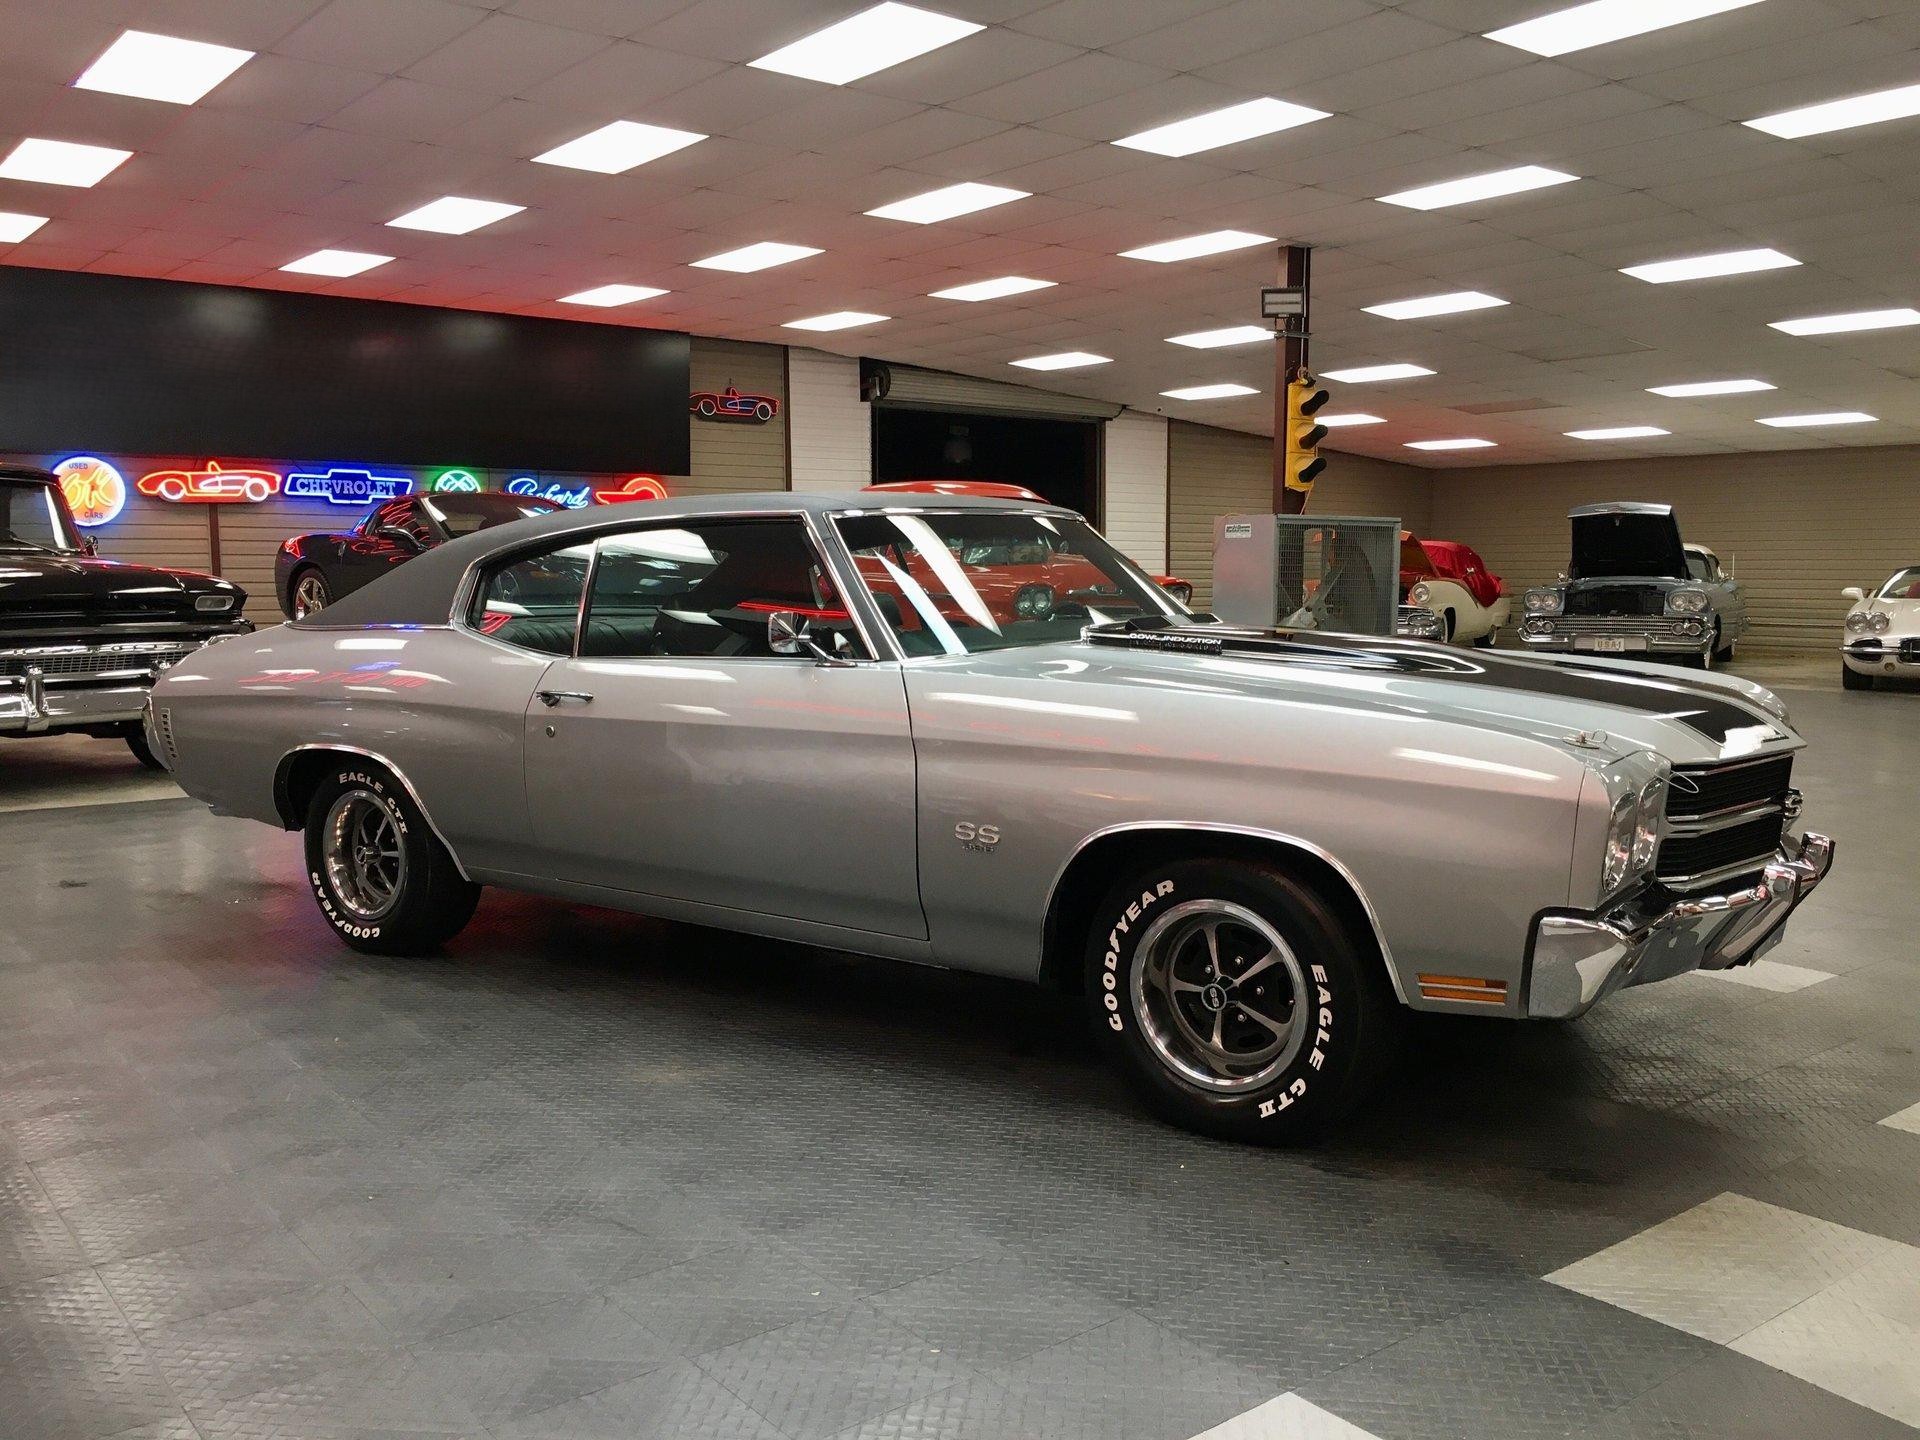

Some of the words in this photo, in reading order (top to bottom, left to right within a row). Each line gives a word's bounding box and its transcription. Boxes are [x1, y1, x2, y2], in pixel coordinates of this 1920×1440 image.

[62, 466, 114, 510] OK
[295, 478, 397, 496] CHEVROLET
[84, 511, 104, 519] CARS
[338, 772, 384, 794] EAGLE
[954, 821, 1000, 845] SS
[311, 872, 381, 938] GOODYEAR
[1102, 879, 1175, 1032] GOODYEAR
[1308, 964, 1334, 1071] EAGLE
